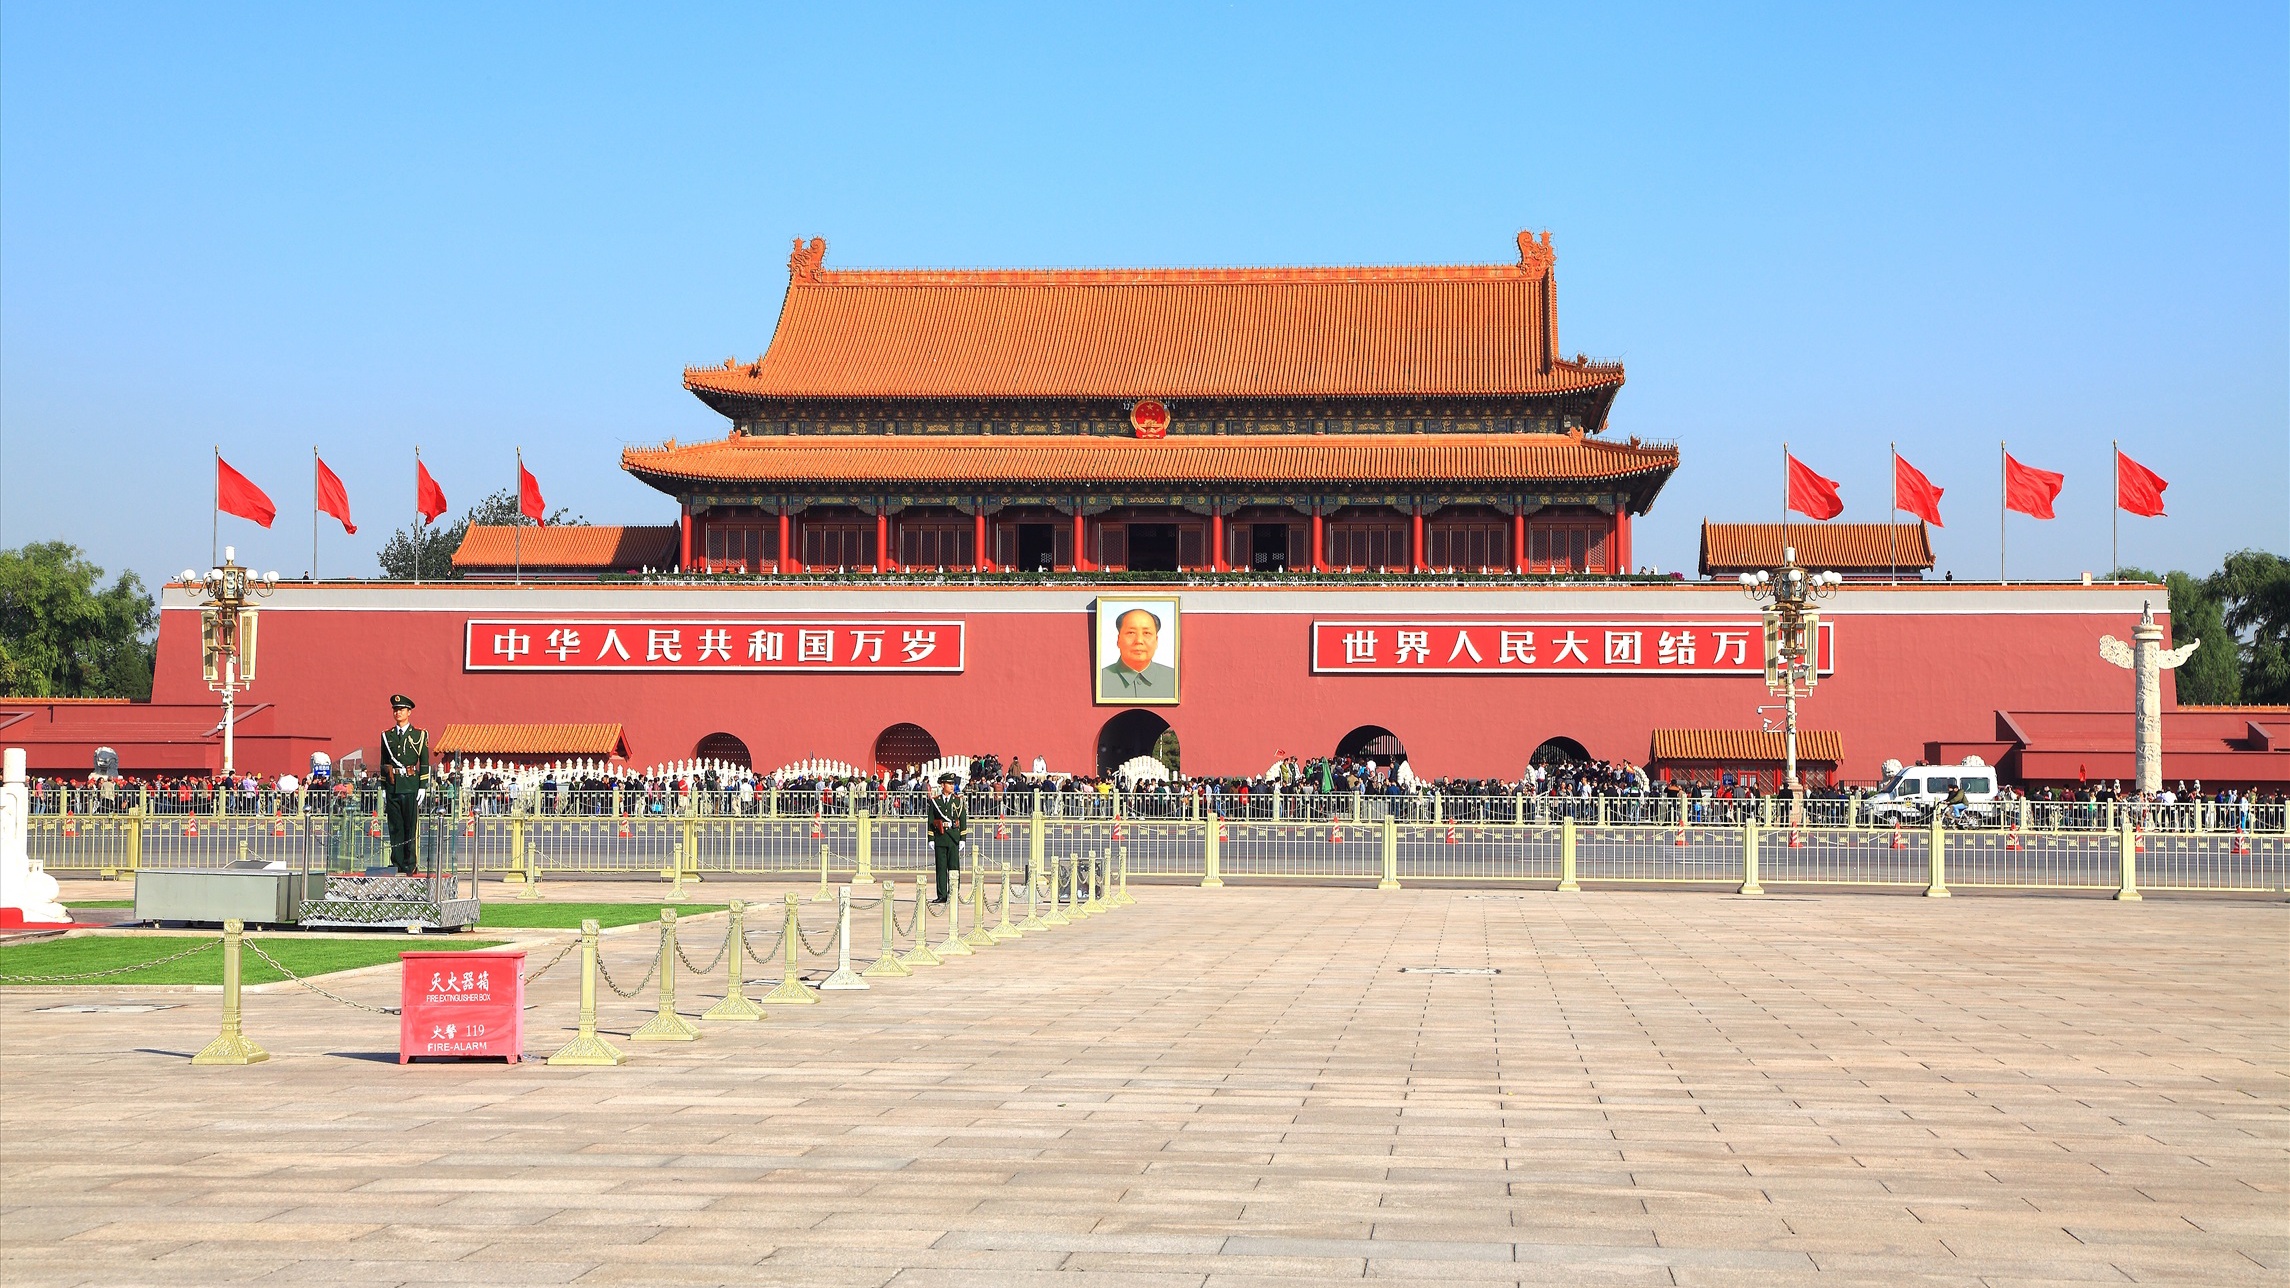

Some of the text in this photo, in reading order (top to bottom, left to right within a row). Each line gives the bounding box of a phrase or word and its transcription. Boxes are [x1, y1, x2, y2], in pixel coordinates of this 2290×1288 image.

[494, 628, 937, 663] 中华人民共和国万岁
[429, 970, 489, 992] 灭火器箱
[426, 993, 491, 1003] FIRE EXTINGUISHER BOX
[431, 1024, 485, 1040] 火警 119
[427, 1041, 487, 1052] FIRE-ALARM
